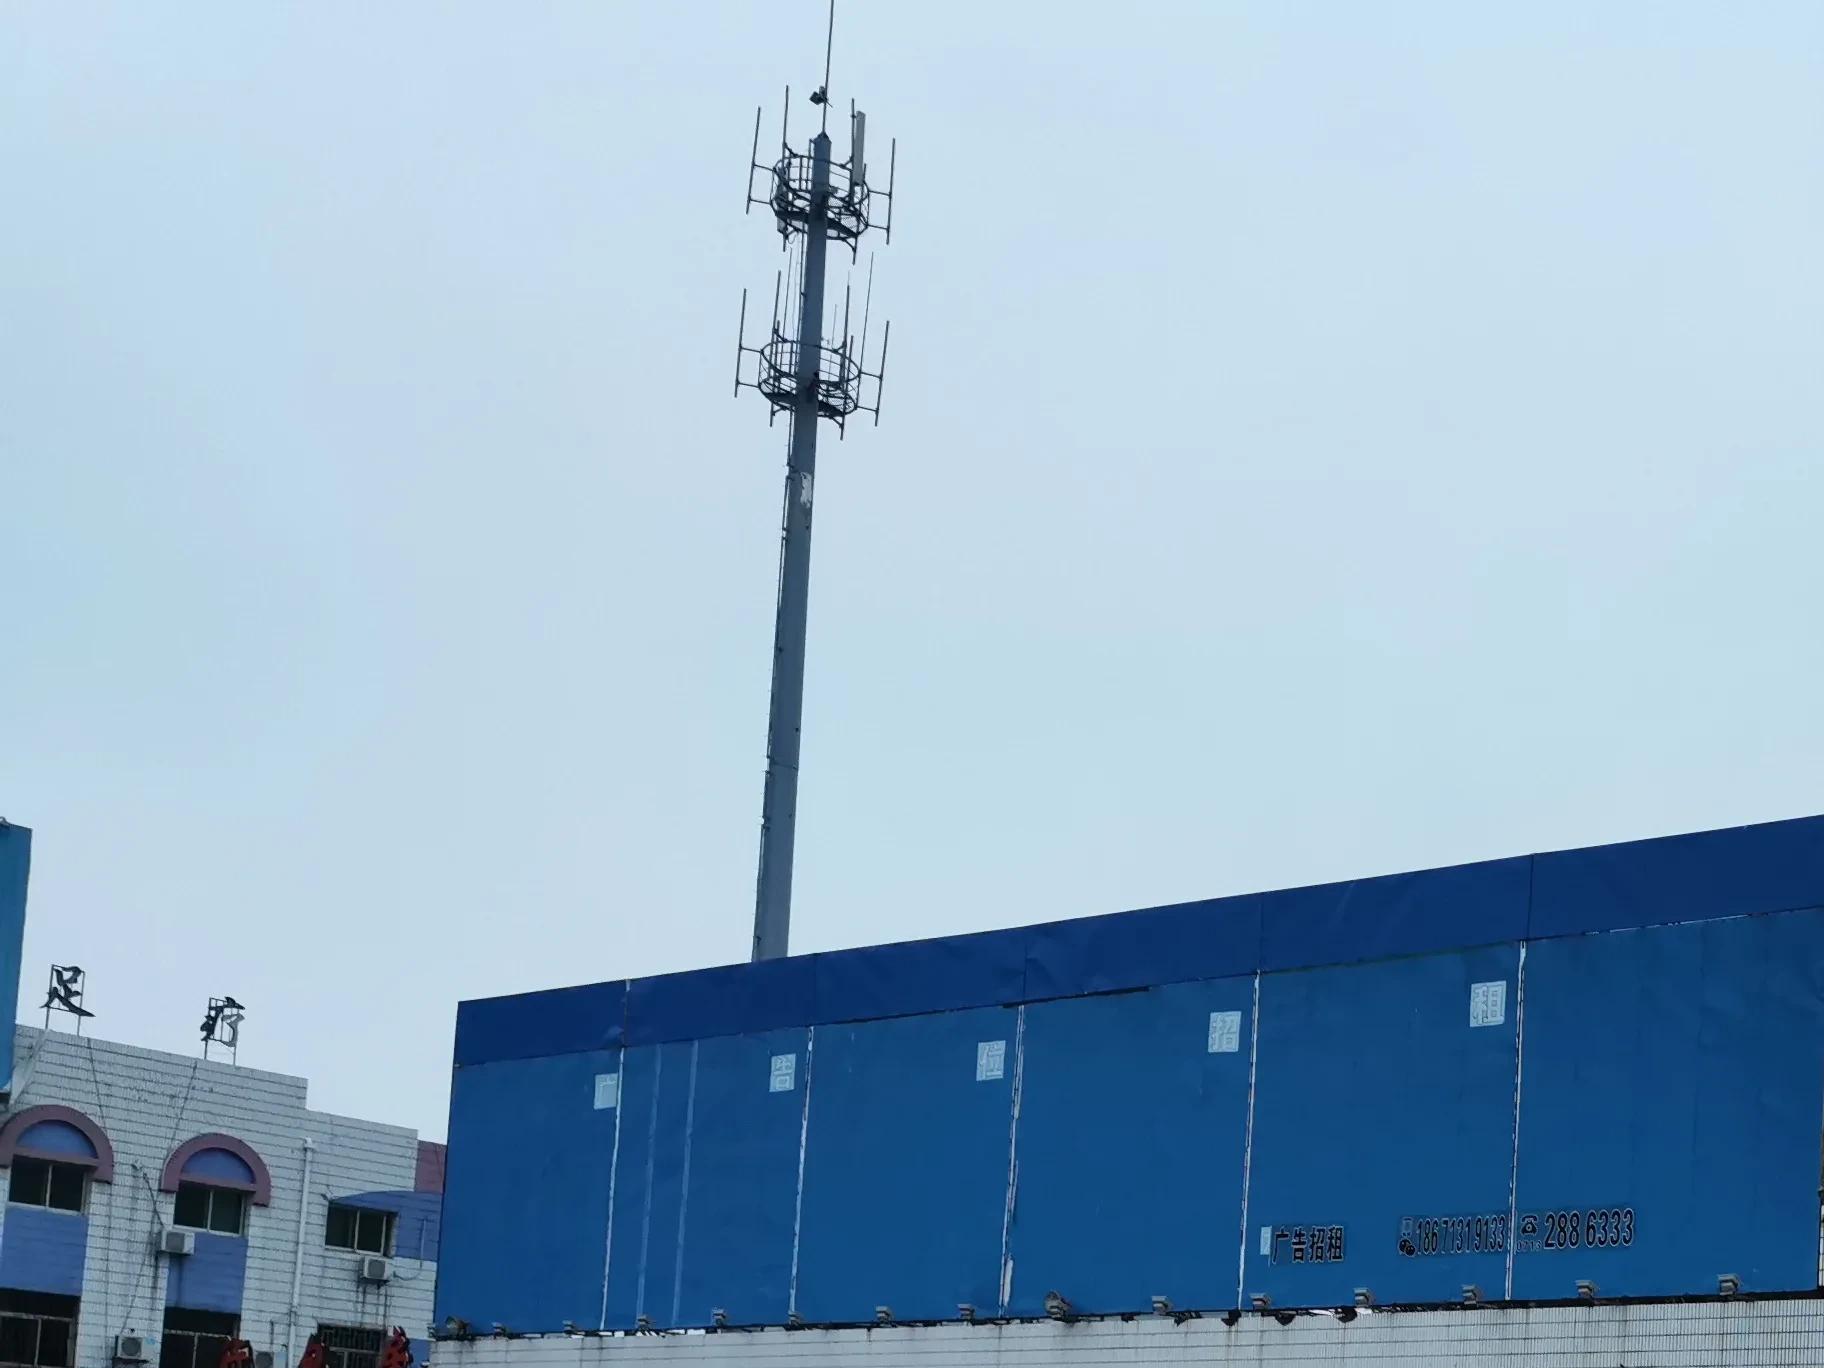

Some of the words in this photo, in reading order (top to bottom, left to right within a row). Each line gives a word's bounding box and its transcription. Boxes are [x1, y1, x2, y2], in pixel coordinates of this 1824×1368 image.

[39, 966, 246, 1047] 足疗
[1272, 1225, 1343, 1264] 广告招租
